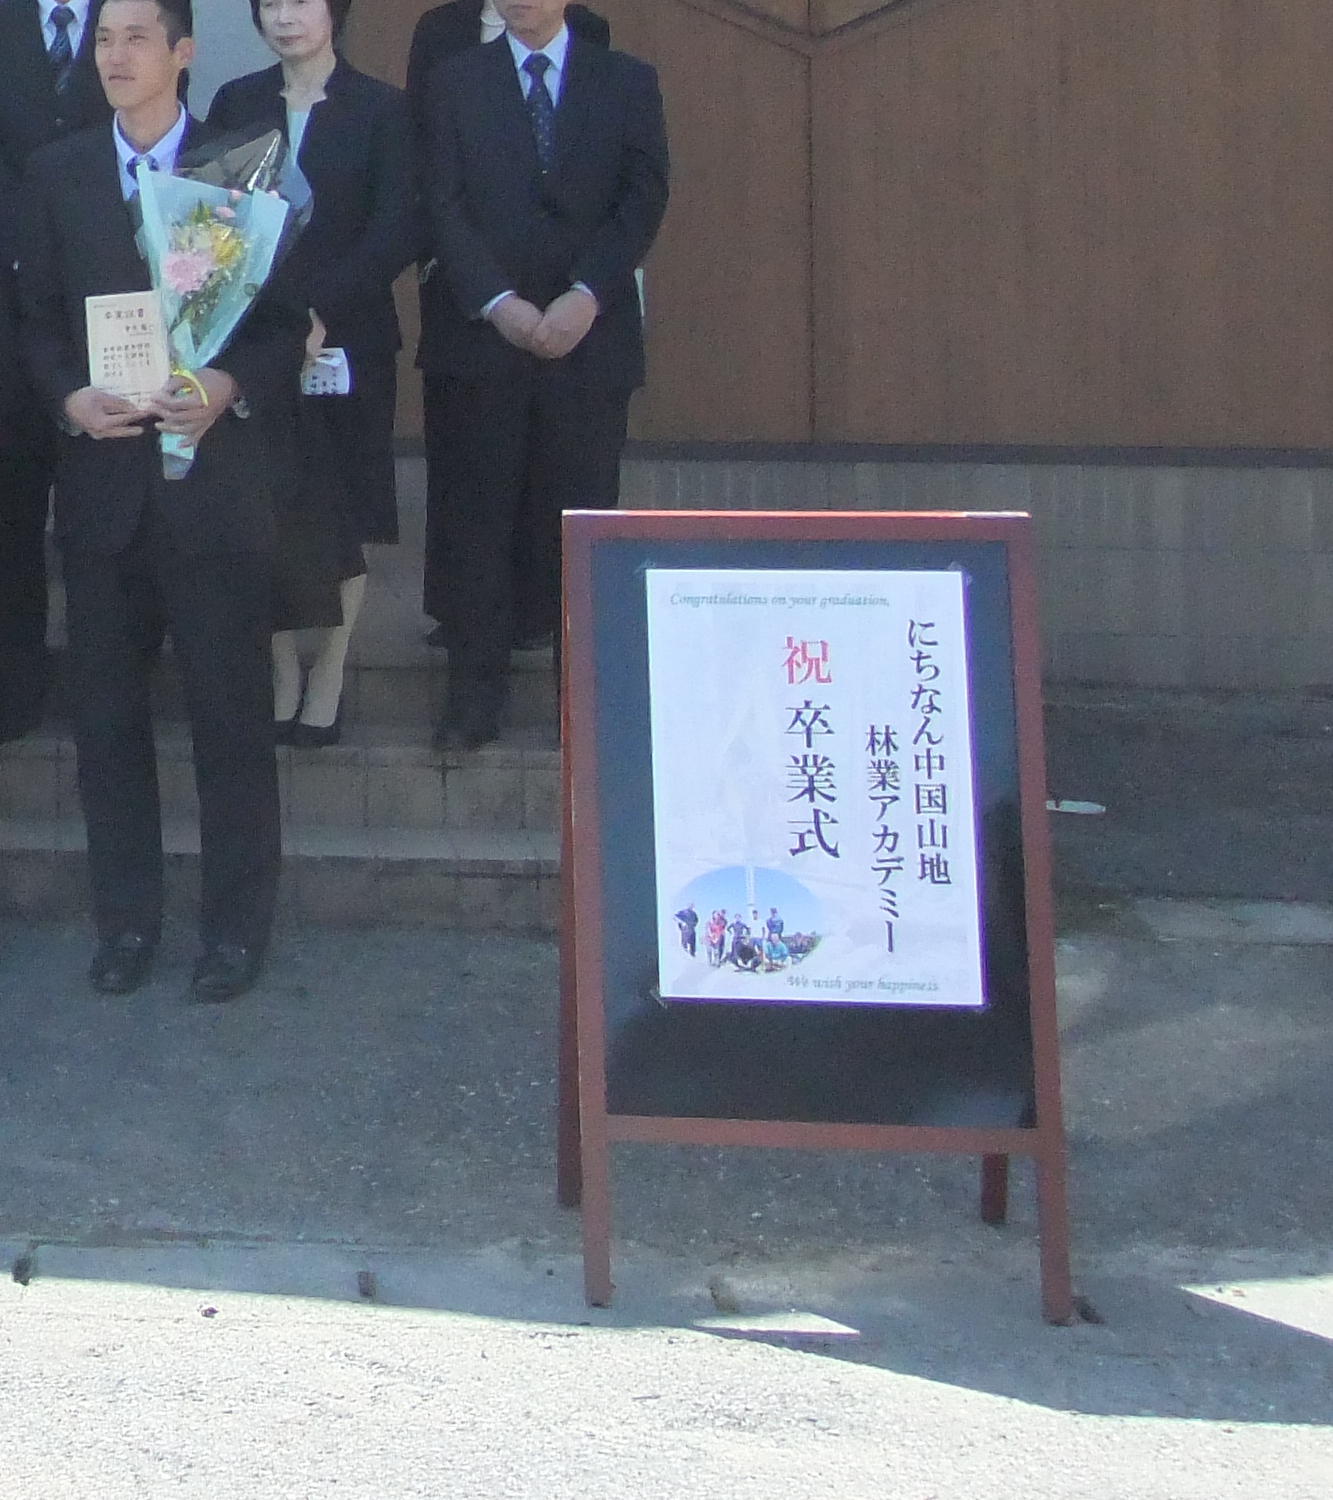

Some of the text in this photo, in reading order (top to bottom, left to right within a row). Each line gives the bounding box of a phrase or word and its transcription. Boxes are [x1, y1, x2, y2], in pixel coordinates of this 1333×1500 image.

[669, 591, 768, 608] Congratulations
[771, 595, 786, 605] on
[788, 594, 817, 609] your
[781, 635, 841, 859] 祝 卒業式
[864, 724, 905, 954] 林業アカデミー
[906, 618, 953, 886] にちなん中国山地
[844, 979, 874, 992] your
